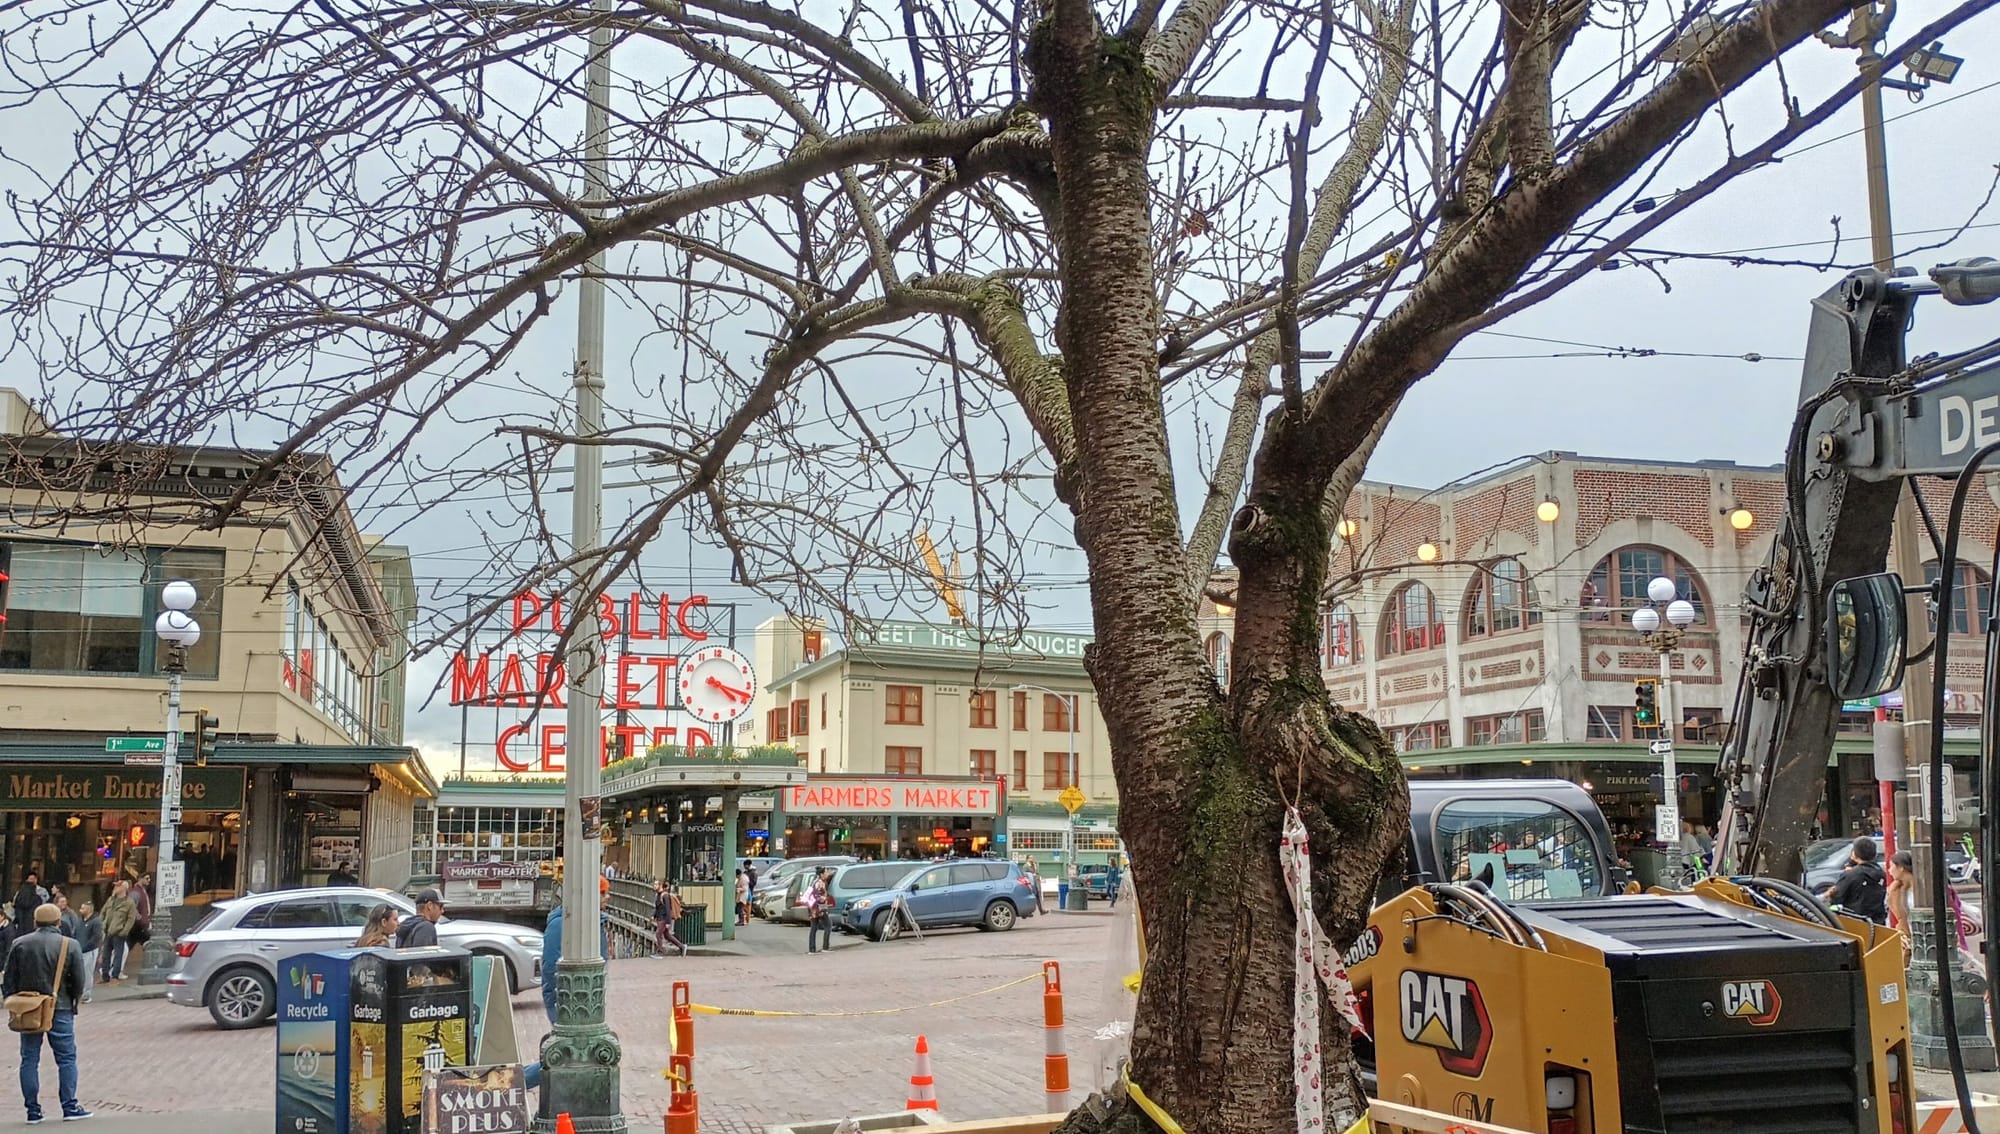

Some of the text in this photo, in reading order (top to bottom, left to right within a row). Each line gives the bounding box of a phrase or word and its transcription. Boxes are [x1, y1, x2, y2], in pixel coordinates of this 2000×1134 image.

[512, 590, 709, 641] PUBLIC
[929, 627, 967, 647] THE
[698, 653, 705, 662] 11
[713, 649, 722, 658] 12
[732, 654, 736, 662] 1
[686, 664, 695, 673] 10
[742, 666, 748, 674] 2
[451, 652, 678, 710] MARET
[682, 680, 688, 688] 9
[746, 681, 751, 690] 3
[686, 696, 692, 704] 8
[698, 708, 704, 716] 7
[713, 712, 719, 720] 6
[731, 708, 736, 717] 5
[111, 739, 160, 750] 1st Ave
[495, 724, 714, 772] CETER
[1606, 776, 1651, 785] PIKE PLAC
[8, 774, 93, 799] Market
[103, 774, 206, 799] Entrace
[792, 786, 991, 808] FARMERS MARKET
[451, 867, 532, 877] MARKET THEATER
[1723, 982, 1766, 1016] CAT
[287, 1003, 329, 1020] Recycle
[354, 1004, 382, 1022] Garbage
[409, 1005, 459, 1019] Garbage
[1400, 970, 1467, 1051] CAT
[441, 1087, 523, 1113] SMOKE
[451, 1111, 513, 1134] PLUS
